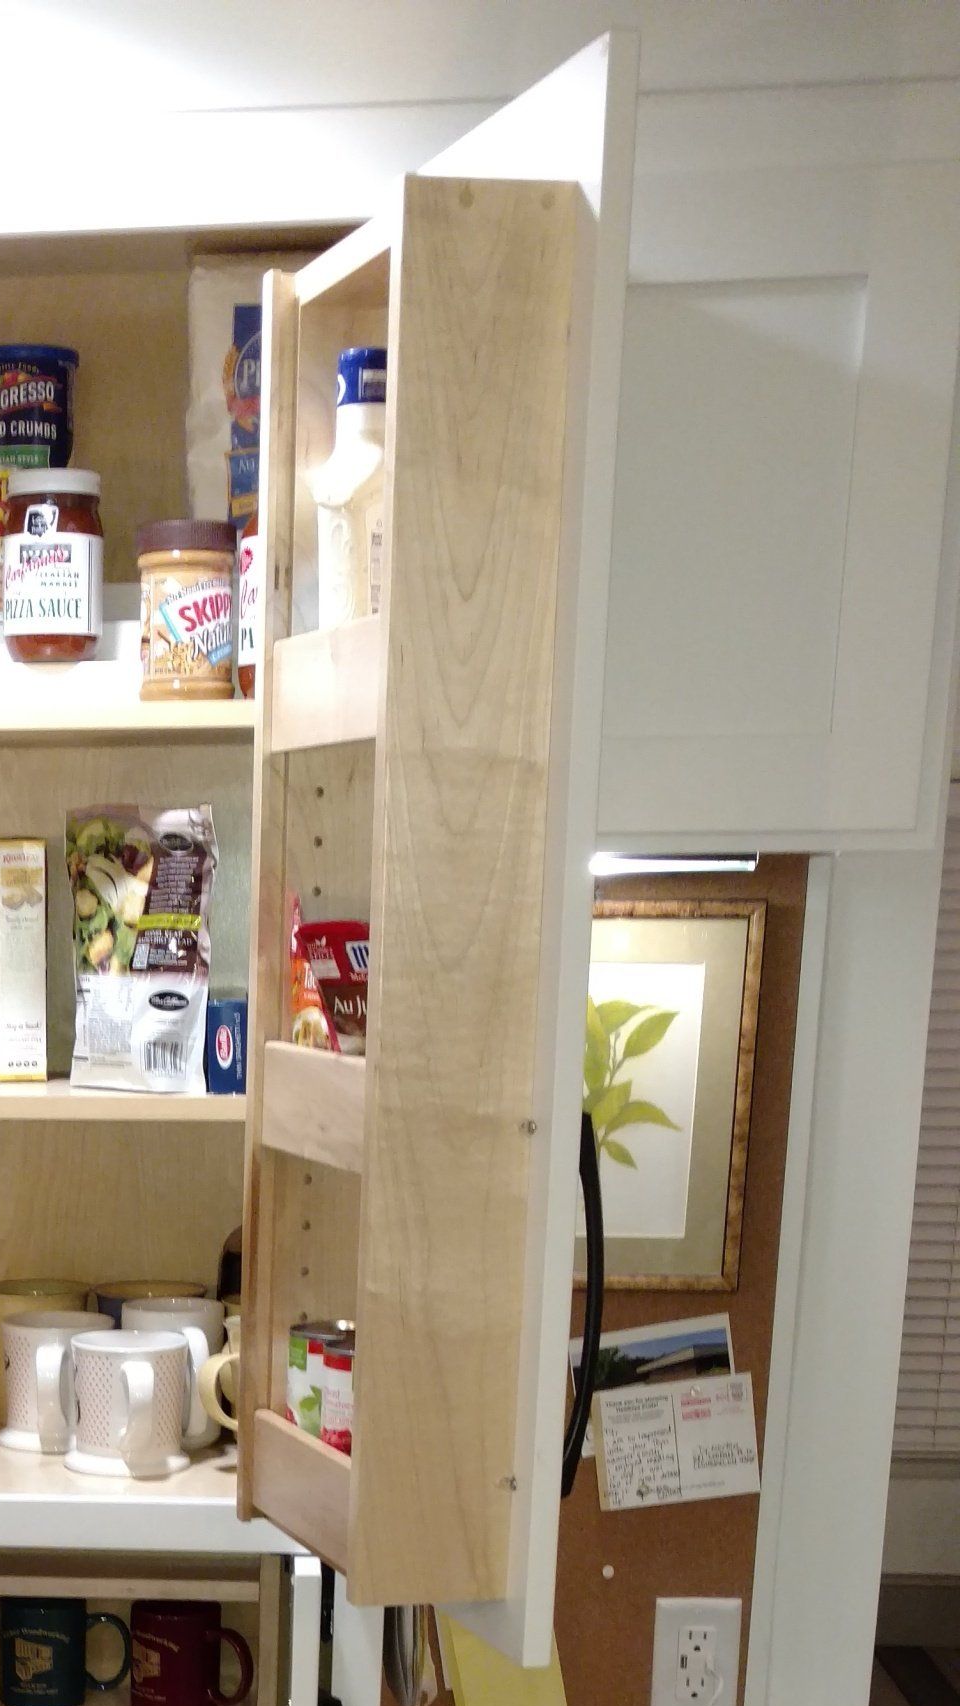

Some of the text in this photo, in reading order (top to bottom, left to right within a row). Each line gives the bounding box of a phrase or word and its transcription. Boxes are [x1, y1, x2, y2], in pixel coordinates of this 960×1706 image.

[10, 420, 57, 440] CRUMBS
[5, 598, 82, 620] PIZZA SAUCE
[333, 995, 368, 1018] Au Ju
